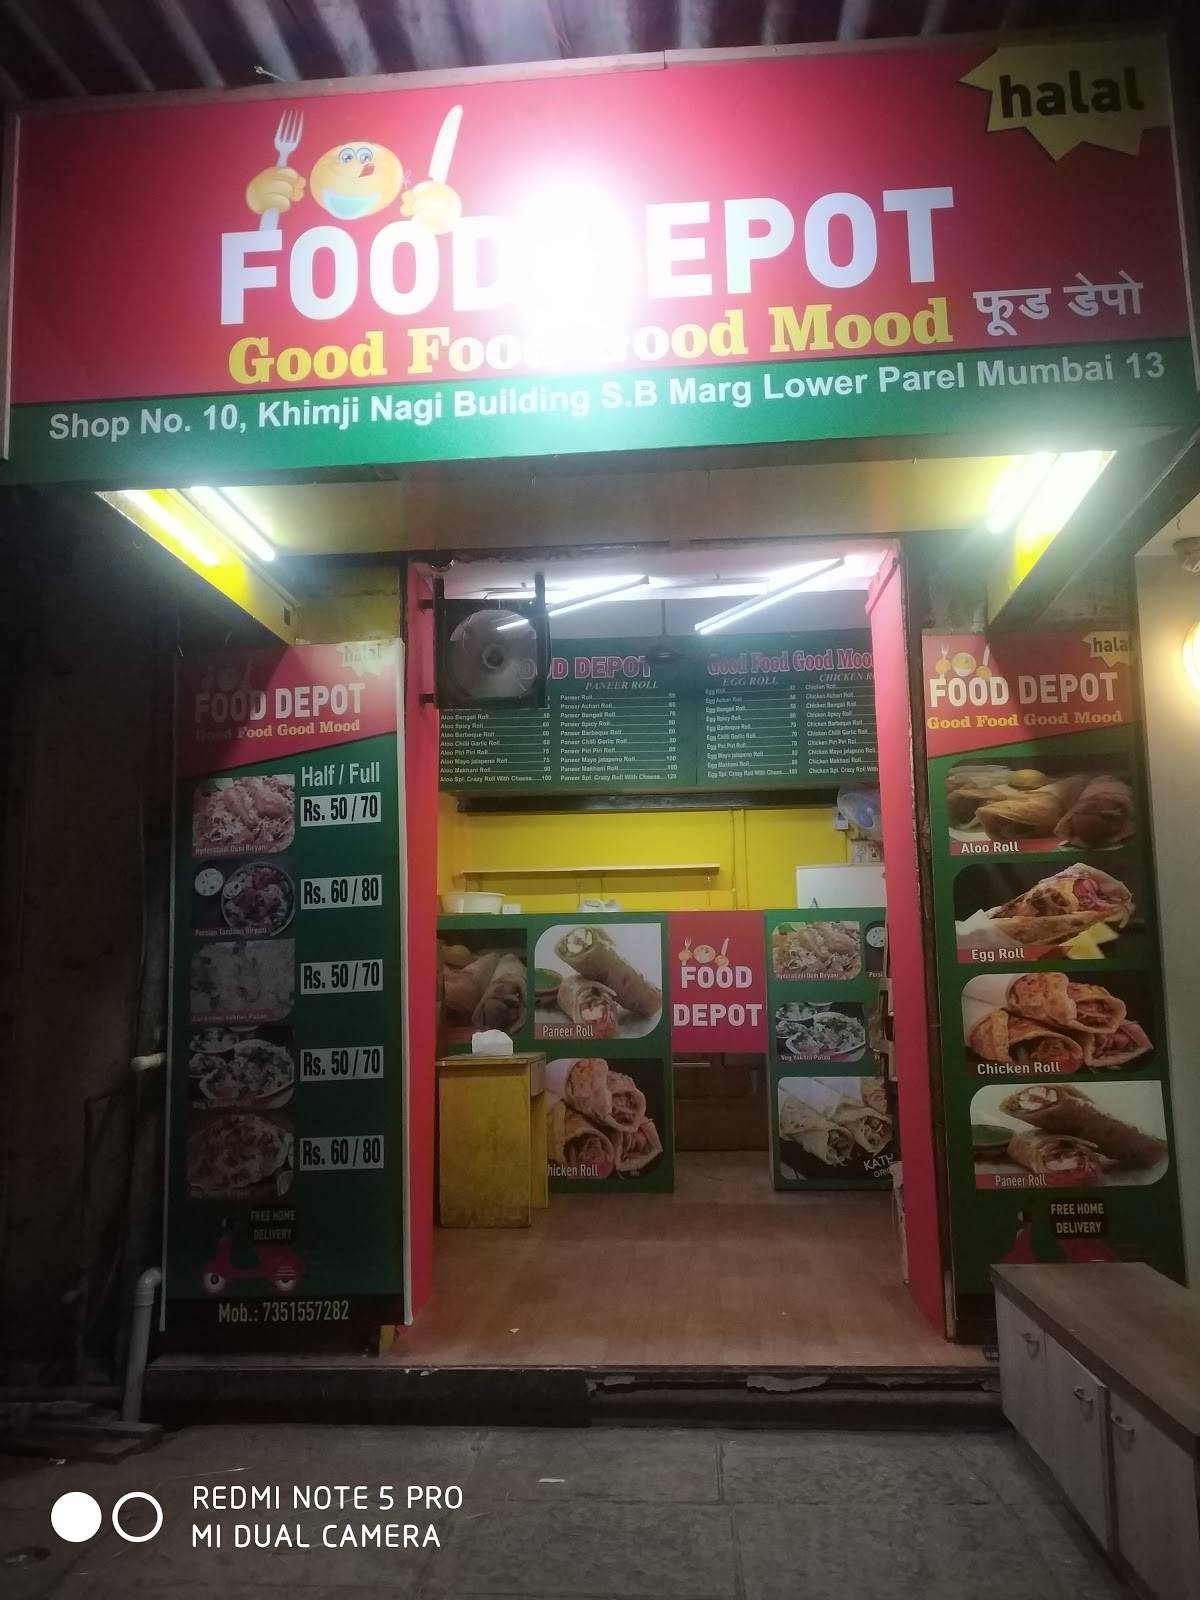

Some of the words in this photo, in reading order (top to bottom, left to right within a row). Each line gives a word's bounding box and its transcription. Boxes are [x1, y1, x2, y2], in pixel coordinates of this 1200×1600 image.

[1000, 66, 1144, 119] halal
[646, 187, 954, 300] EPOT
[973, 287, 1052, 336] फूड
[1063, 269, 1144, 318] डेपो
[229, 331, 387, 384] Good
[622, 309, 748, 362] ood
[768, 297, 954, 353] Mood
[49, 412, 130, 443] Shop
[140, 407, 191, 435] No.
[203, 403, 247, 433] 10,
[258, 397, 359, 430] Khimji
[370, 391, 442, 426] Nagi
[454, 386, 590, 417] Building
[601, 379, 658, 409] S.B
[669, 376, 751, 408] Marg
[763, 373, 868, 400] Lower
[878, 362, 965, 393] Parel
[977, 354, 1113, 387] Mumbai
[1126, 351, 1165, 379] 13
[574, 655, 651, 680] DEPOT
[793, 649, 834, 672] Good
[837, 648, 874, 670] Moo
[631, 680, 659, 689] ROLL
[722, 677, 747, 687] EGG
[749, 676, 778, 686] ROLL
[929, 676, 1009, 708] FOOD
[1018, 671, 1119, 705] DEPOT
[194, 690, 268, 723] FOOD
[275, 683, 366, 720] DEPOT
[237, 724, 273, 740] Food
[277, 721, 316, 737] Good
[320, 718, 361, 733] Mood
[927, 716, 971, 729] Good
[976, 714, 1019, 728] Food
[1024, 712, 1069, 726] Good
[1074, 710, 1123, 724] Mood
[301, 764, 335, 787] Half
[338, 764, 345, 785] /
[349, 762, 380, 784] Full
[303, 799, 326, 822] Rs.
[330, 797, 348, 820] 50
[361, 794, 380, 819] 70
[961, 842, 990, 854] Aloo
[993, 841, 1019, 852] Roll
[303, 881, 326, 904] Rs.
[330, 879, 348, 902] 60
[361, 876, 380, 901] 80
[971, 948, 995, 963] Egg
[999, 947, 1025, 960] Roll
[303, 966, 326, 989] Rs.
[330, 964, 348, 987] 50
[361, 961, 380, 986] 70
[680, 966, 753, 989] FOOD
[673, 1003, 763, 1026] DEPOT
[542, 1024, 573, 1039] Paneer
[576, 1024, 594, 1038] Roll
[303, 1053, 326, 1076] Rs.
[330, 1051, 348, 1074] 50
[361, 1048, 380, 1073] 70
[977, 1062, 1031, 1076] Chicken
[1034, 1061, 1061, 1073] Roll
[303, 1142, 326, 1165] Rs.
[330, 1140, 348, 1163] 60
[361, 1137, 380, 1162] 80
[547, 1163, 578, 1177] hicken
[580, 1163, 599, 1177] Roll
[995, 1175, 1026, 1188] Paneer
[1028, 1174, 1048, 1187] Roll
[249, 1210, 272, 1222] FREE
[273, 1209, 296, 1221] HOME
[1050, 1203, 1076, 1215] FREE
[1076, 1202, 1105, 1214] HOME
[253, 1228, 293, 1241] DELIVERY
[1056, 1222, 1102, 1234] DELIVERY
[218, 1303, 259, 1323] Mob.:
[263, 1300, 350, 1321] 7351557282
